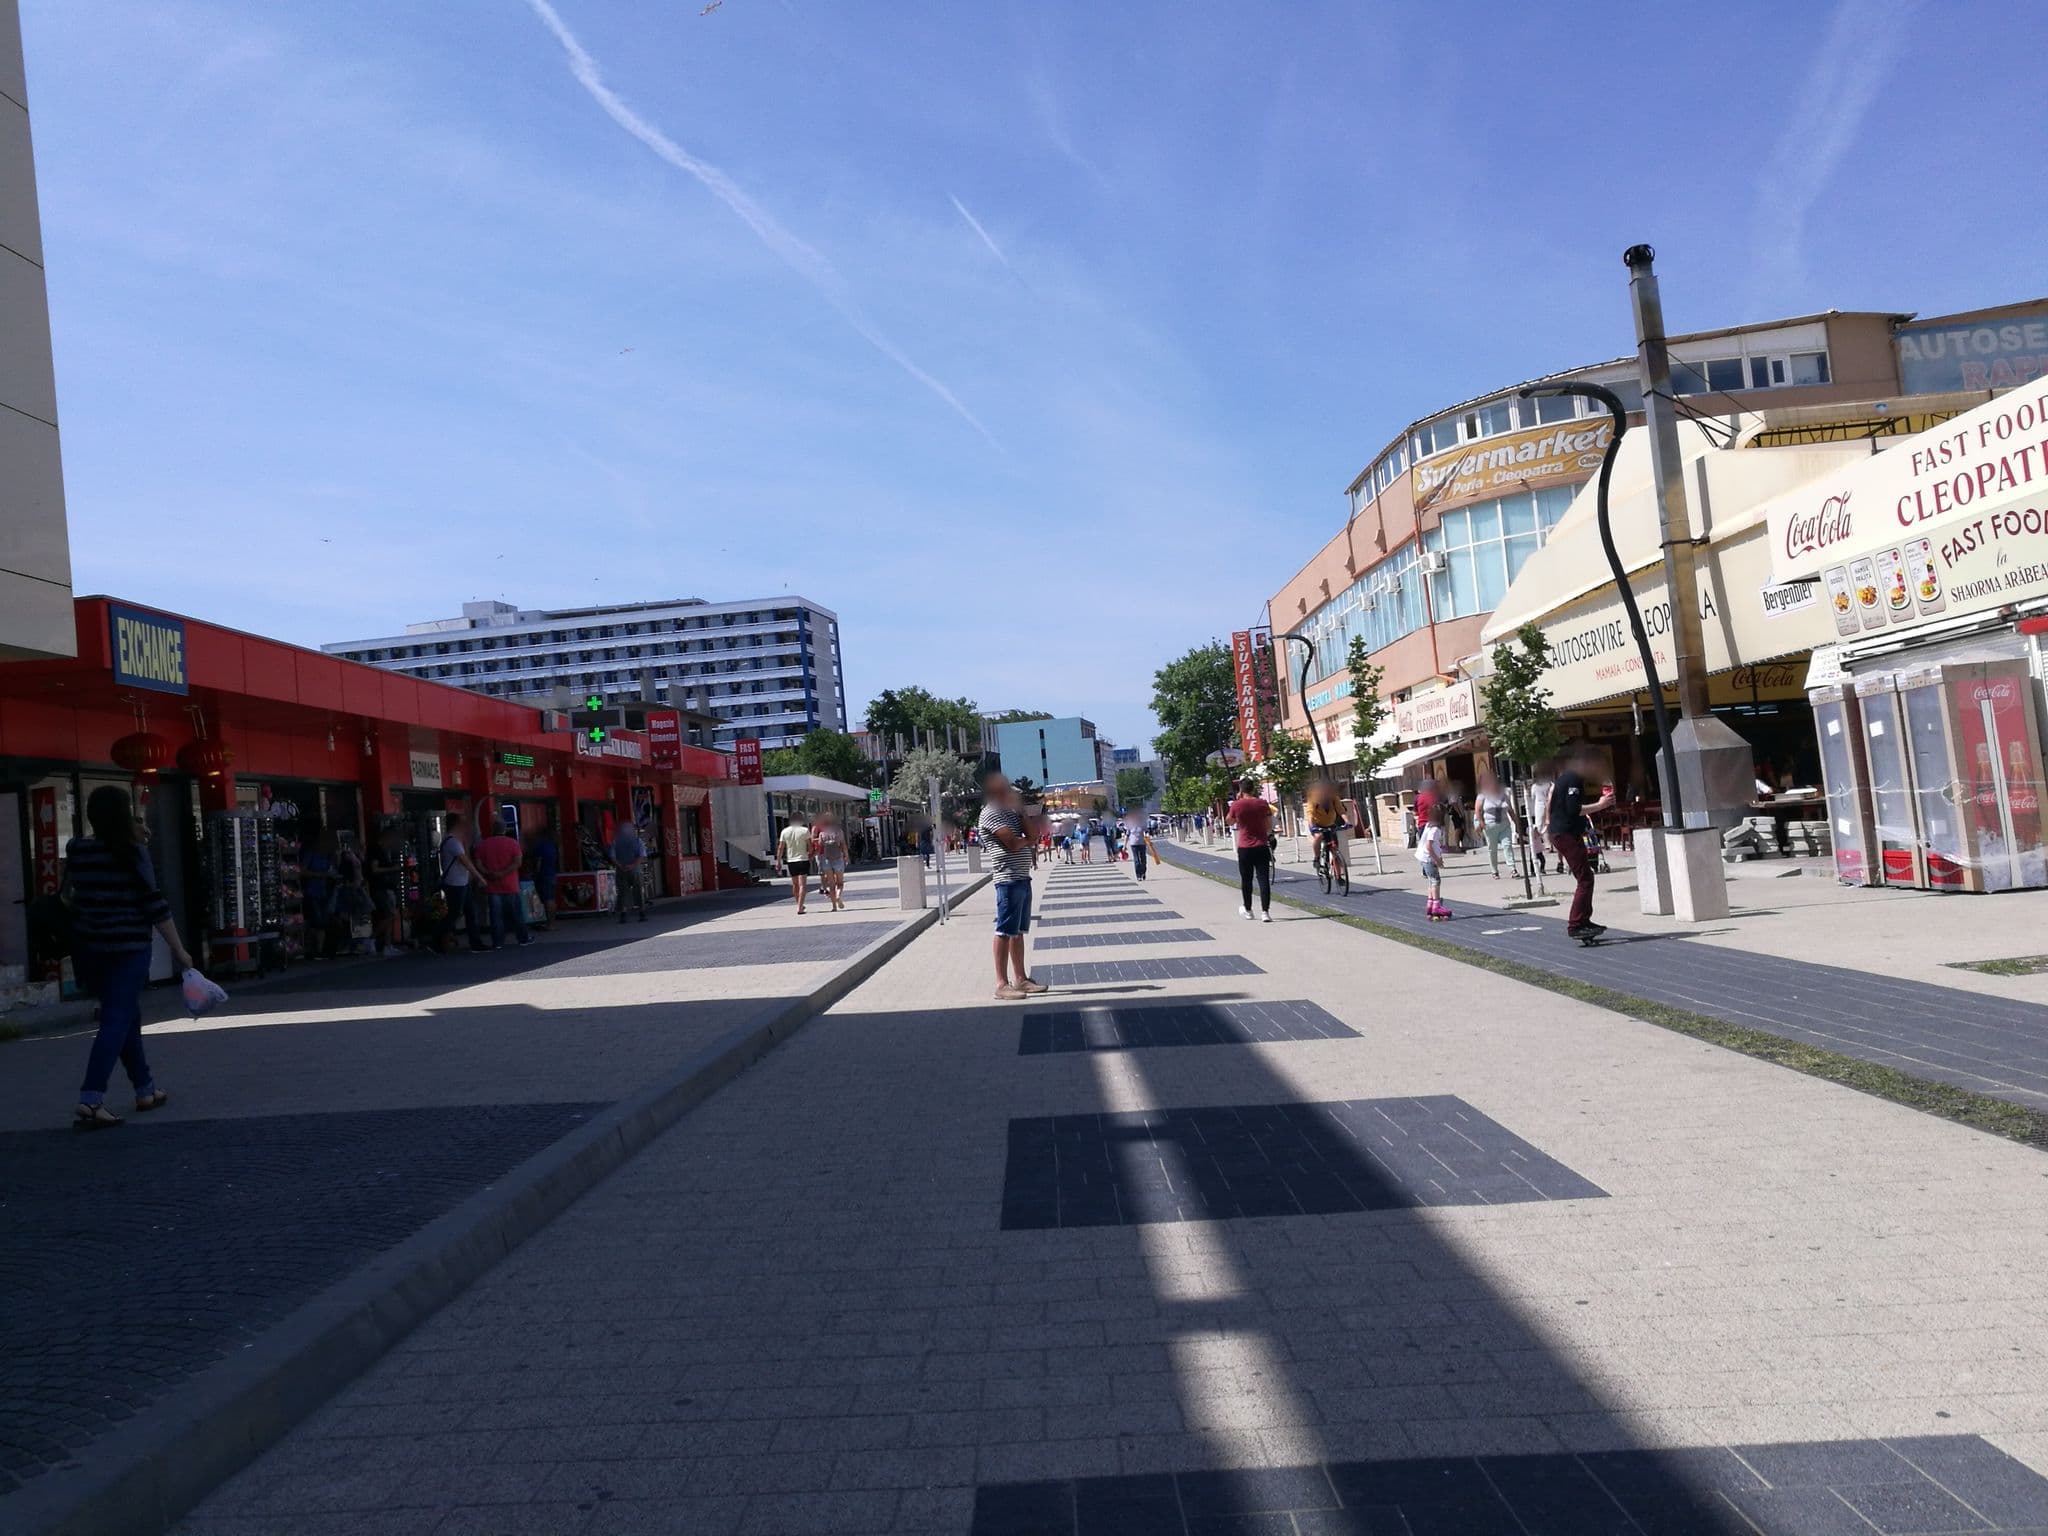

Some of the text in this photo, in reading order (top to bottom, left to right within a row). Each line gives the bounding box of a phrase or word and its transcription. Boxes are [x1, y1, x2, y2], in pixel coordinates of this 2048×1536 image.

[1492, 461, 1564, 485] Cleopatra
[1911, 431, 1969, 478] FAST
[1941, 508, 2048, 569] FAST FOO
[1951, 561, 2048, 603] SHAORMA ARĂBEA
[118, 616, 183, 684] EXCHANGE
[1552, 619, 1625, 668] AUTOSERVIRE
[1238, 640, 1258, 763] SUPERMARKET
[1416, 712, 1449, 734] CLEOPATRA
[740, 743, 756, 753] FAST
[740, 755, 758, 766] FOOD
